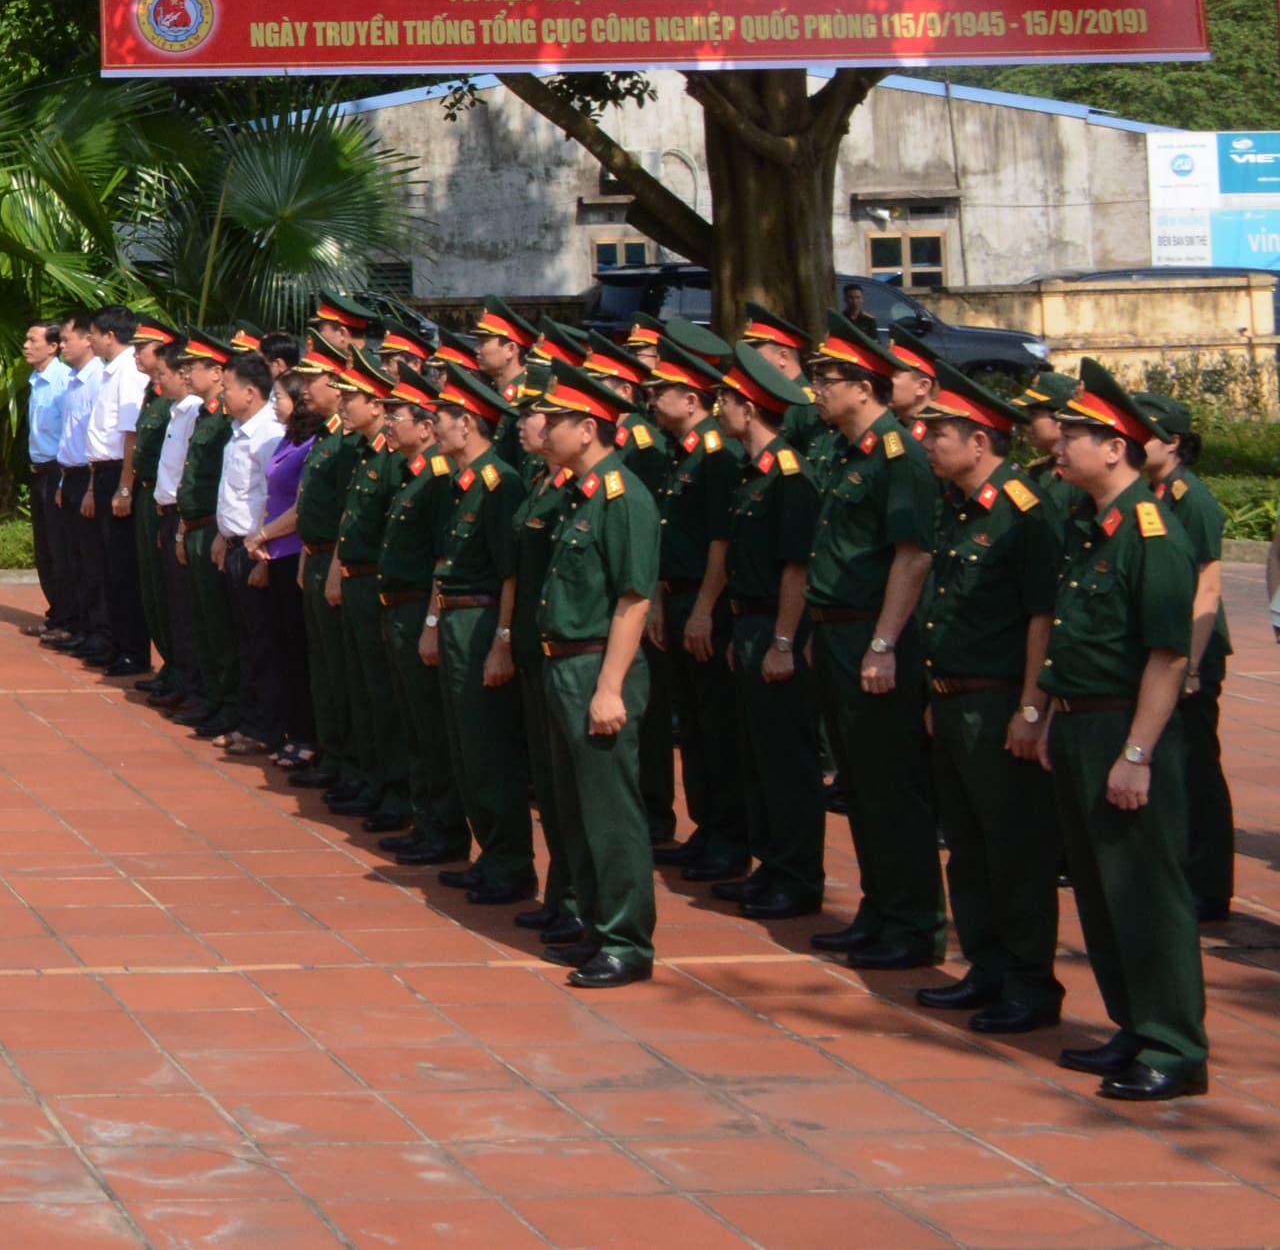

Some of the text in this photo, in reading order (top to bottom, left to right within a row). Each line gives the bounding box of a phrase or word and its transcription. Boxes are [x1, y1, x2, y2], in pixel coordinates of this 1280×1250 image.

[250, 15, 308, 47] NGÀY
[313, 13, 400, 47] TRUYỀN
[403, 12, 476, 46] THỐNG
[479, 9, 537, 44] TỔNG
[541, 17, 586, 48] CỤC
[591, 12, 651, 43] CÔNG
[655, 10, 736, 46] NGHIỆP
[741, 7, 800, 43] QUỐC
[804, 8, 877, 39] PHÒNG
[882, 11, 1007, 39] (15/9/1945
